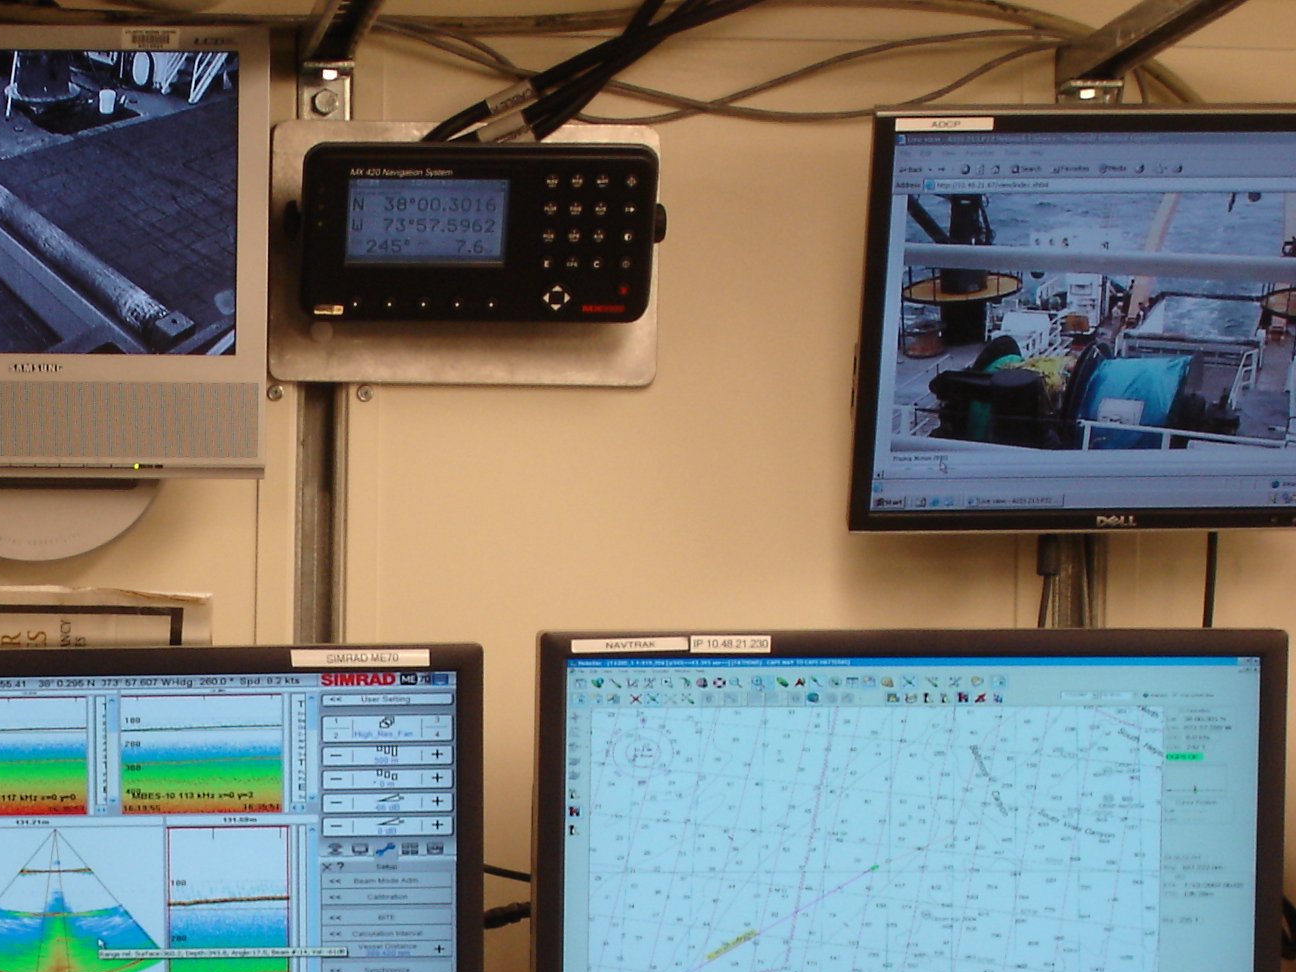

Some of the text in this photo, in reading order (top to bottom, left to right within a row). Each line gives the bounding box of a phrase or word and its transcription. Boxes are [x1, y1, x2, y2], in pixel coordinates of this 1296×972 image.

[931, 120, 962, 129] ADCP
[350, 168, 454, 178] MX 420 Navigation System
[353, 198, 365, 212] N
[351, 218, 364, 232] W
[456, 239, 485, 254] 7.6
[593, 260, 601, 268] C
[8, 363, 63, 373] SAMSUNG
[1096, 515, 1137, 527] DELL
[605, 642, 655, 650] NAVTRAK
[693, 639, 769, 650] IP 10.48.21.230
[326, 653, 399, 664] SIMRAD ME70
[239, 678, 261, 687] Spd
[284, 677, 301, 686] kts
[320, 672, 397, 687] SIMRAD
[401, 674, 417, 685] ME
[19, 793, 37, 802] kHz
[197, 791, 215, 800] kHz
[367, 893, 409, 901] Calibration
